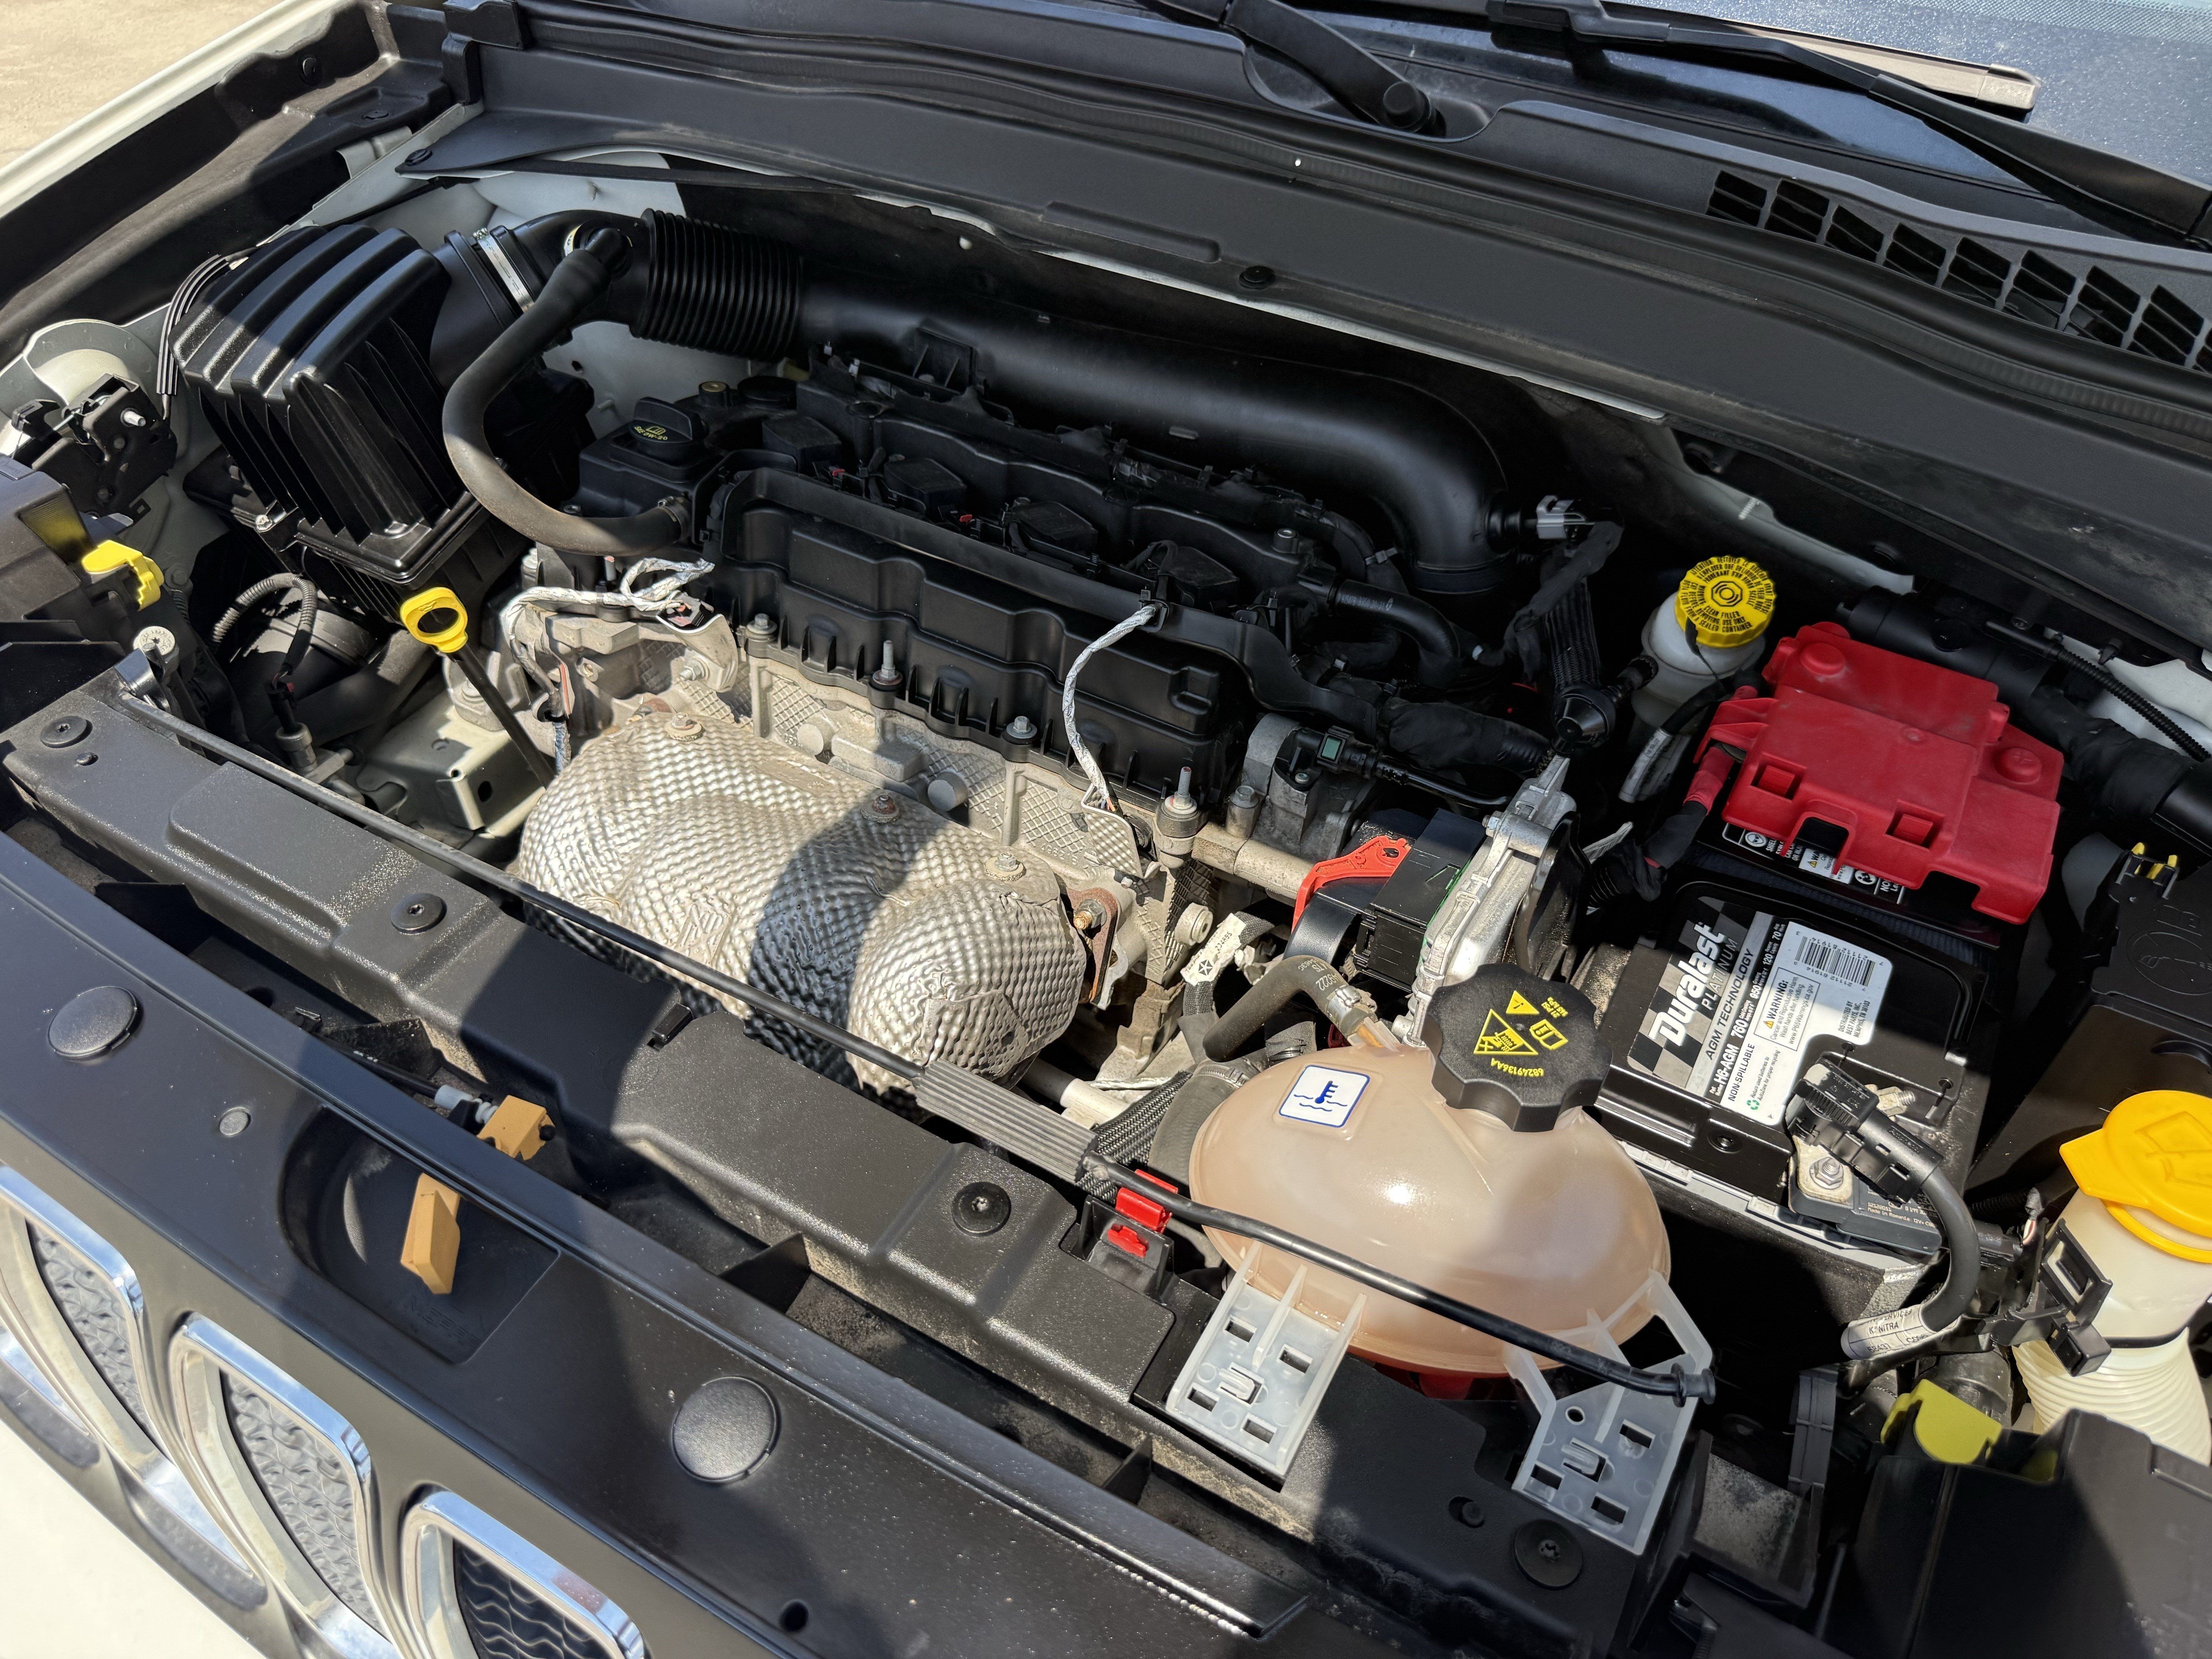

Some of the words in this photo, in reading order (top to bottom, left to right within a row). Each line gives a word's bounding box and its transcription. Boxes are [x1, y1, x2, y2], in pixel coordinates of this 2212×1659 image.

[1703, 605, 1719, 616] CLEAN
[1698, 619, 1719, 631] SEALED
[1722, 622, 1753, 632] CONTAINER
[1733, 617, 1747, 625] ONLY
[1765, 837, 1778, 853] SHIEL
[1771, 930, 1783, 941] 70
[1810, 935, 1838, 951] 81914
[1762, 952, 1774, 967] 120
[1841, 946, 1868, 961] 21112
[1701, 938, 1738, 1010] PLATINUM
[1805, 966, 1828, 978] 81914
[1648, 923, 1725, 1046] Duralast
[1829, 974, 1853, 987] 21112
[1748, 983, 1763, 1000] 950
[1766, 979, 1788, 1020] WARNING:
[1540, 1001, 1554, 1013] PSI
[1705, 1029, 1723, 1060] AGM
[1717, 948, 1753, 1026] TECHNOLOGY
[1779, 988, 1795, 1016] Reproductive
[1788, 1001, 1797, 1012] after
[1550, 1010, 1561, 1019] 21
[1776, 1015, 1784, 1025] and
[1783, 1011, 1793, 1025] hands
[1787, 983, 1815, 1045] www.P65Warnings.ca.gov
[1838, 1006, 1851, 1032] DISTRIBUTED
[1848, 1009, 1859, 1025] PARTS,
[1730, 1018, 1749, 1040] 760
[1769, 1024, 1781, 1041] Cancer
[1779, 1024, 1789, 1038] Wash
[1844, 1024, 1854, 1035] BEST
[1853, 1017, 1865, 1037] MEMPHIS,
[1490, 1057, 1543, 1077] 68249136AA
[1713, 1042, 1740, 1085] H6-AGM
[1727, 1042, 1755, 1102] NON-SPILLABLE
[1750, 1085, 1759, 1098] Return
[1758, 1060, 1768, 1077] batteries
[1757, 1083, 1768, 1101] AutoZone
[1765, 1065, 1774, 1079] proper
[1869, 1321, 1899, 1334] KNITRA
